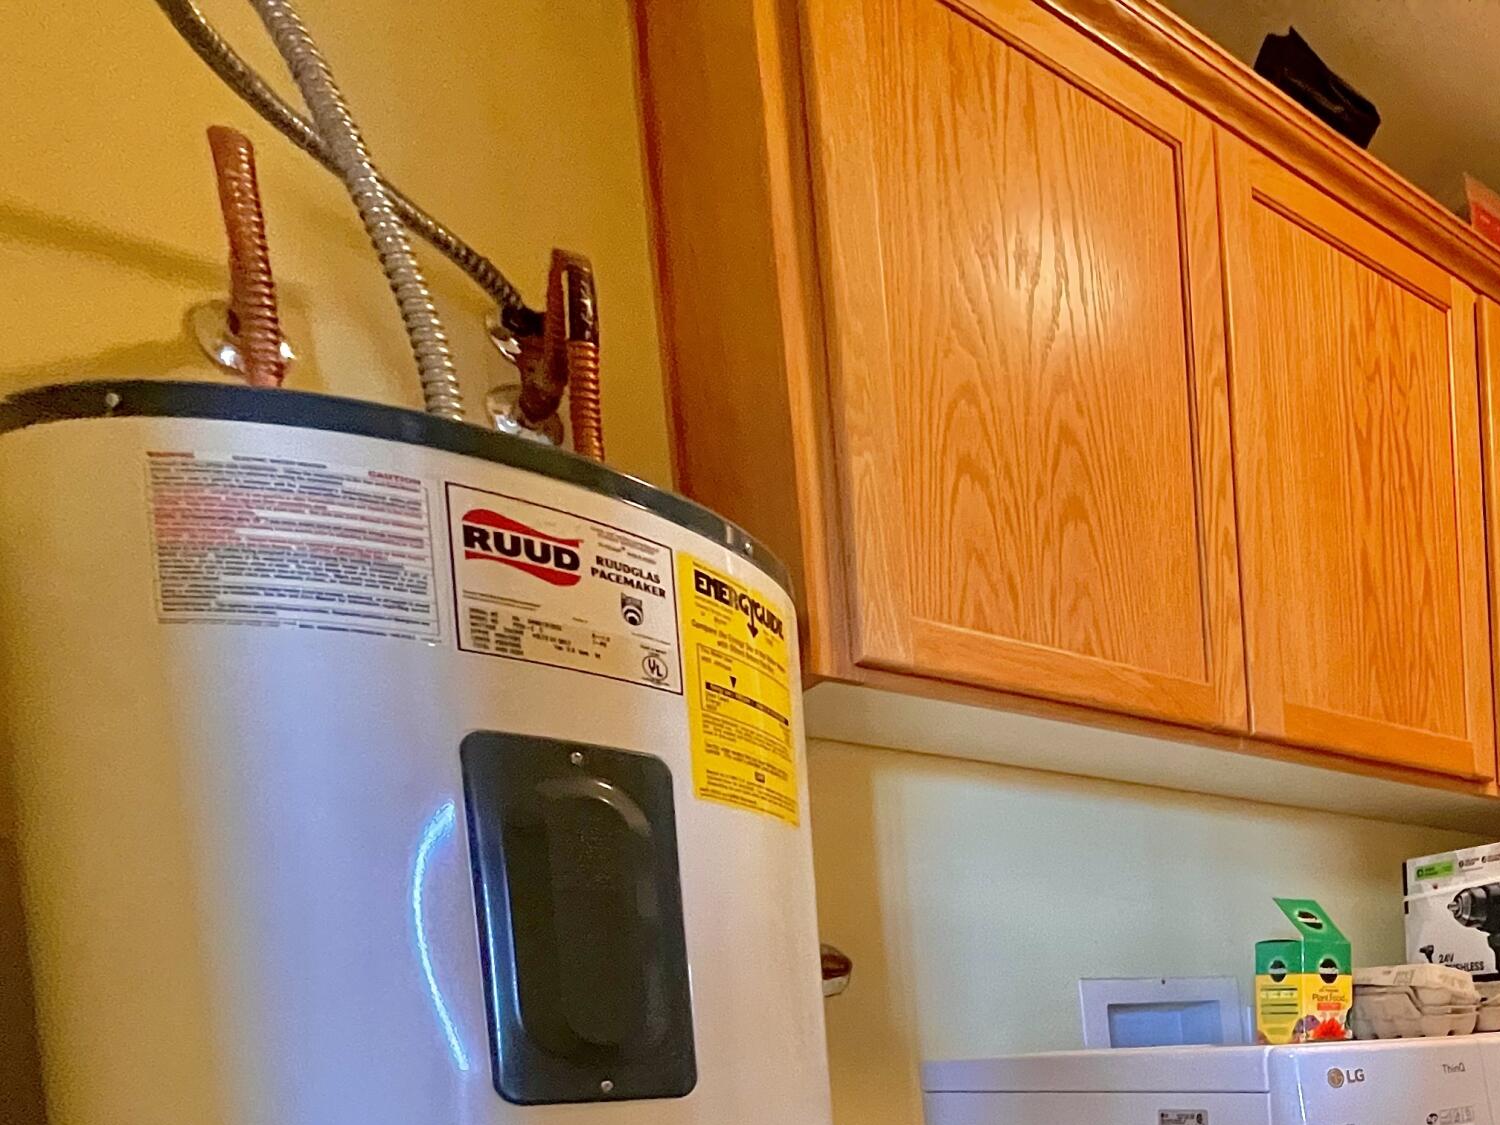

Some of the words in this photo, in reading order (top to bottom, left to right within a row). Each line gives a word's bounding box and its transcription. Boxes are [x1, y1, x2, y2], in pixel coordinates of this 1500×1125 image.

[462, 524, 581, 571] RUUD
[595, 555, 661, 585] RUUDGLAS
[590, 566, 667, 599] PACEMAKER
[1438, 953, 1454, 963] 24V
[1346, 1068, 1365, 1083] LG
[1442, 1062, 1466, 1074] ThinQ
